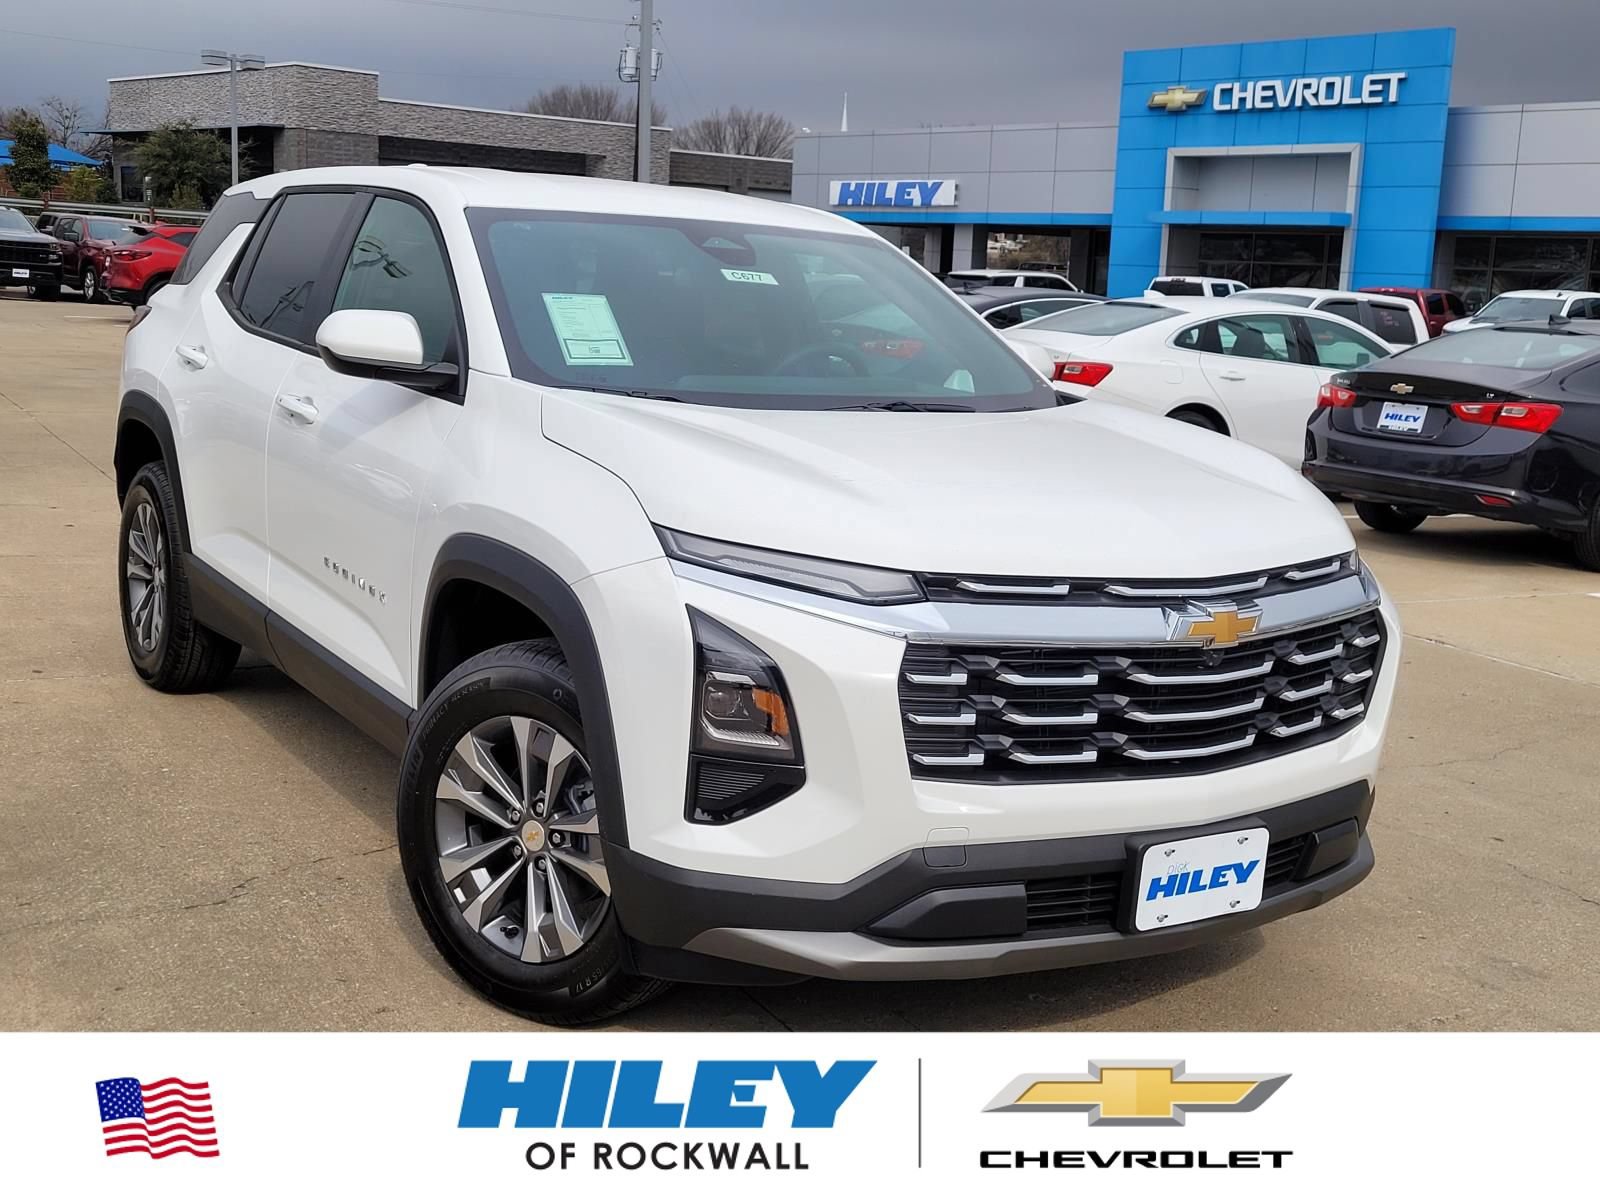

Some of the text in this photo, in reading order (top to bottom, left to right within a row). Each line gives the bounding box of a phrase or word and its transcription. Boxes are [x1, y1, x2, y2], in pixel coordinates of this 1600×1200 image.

[1213, 72, 1407, 111] CHEVROLET
[838, 181, 944, 207] HILEY
[731, 271, 763, 281] C677
[1384, 412, 1421, 423] HILEY
[1146, 859, 1260, 901] HILEY
